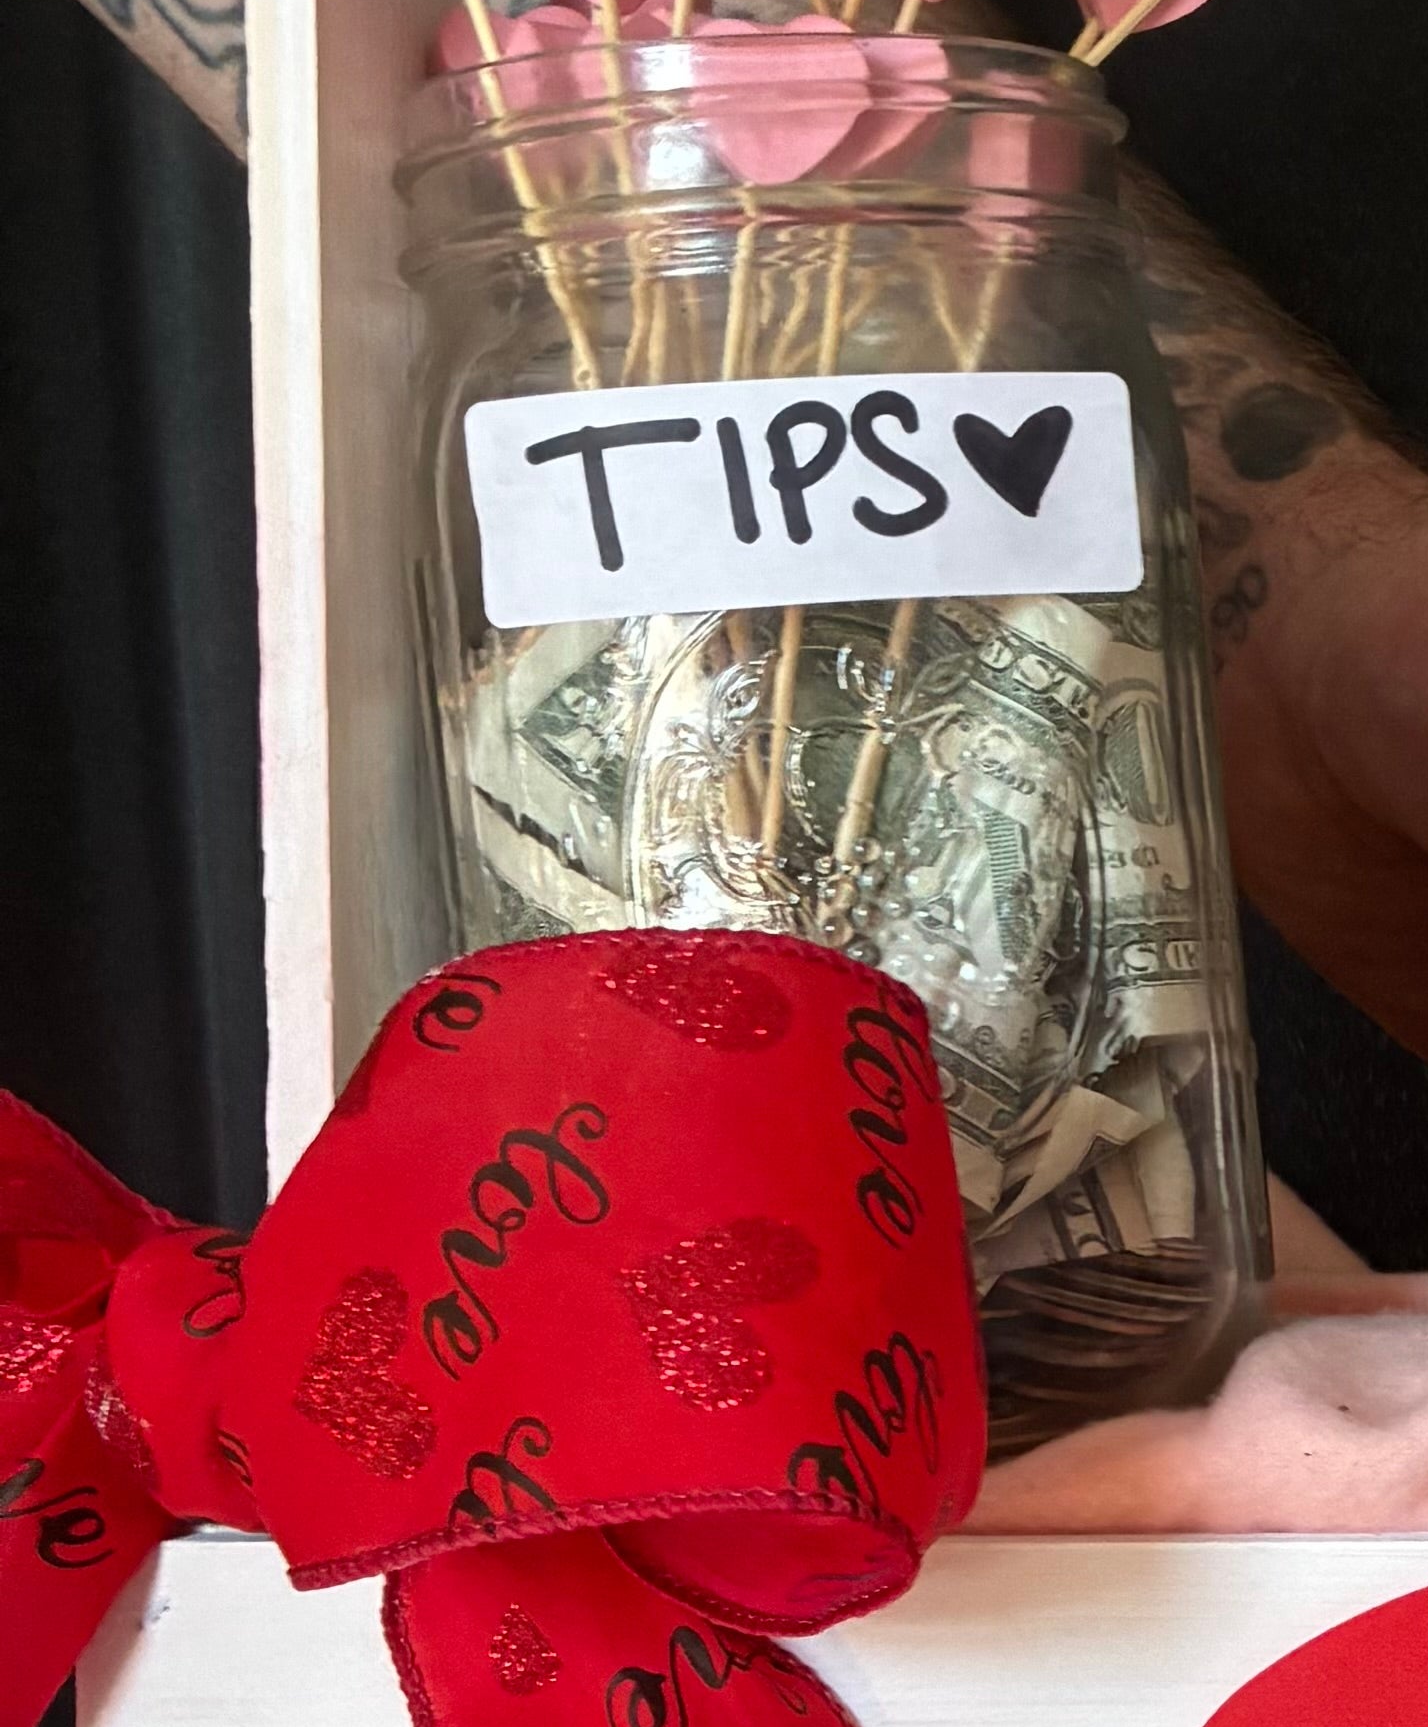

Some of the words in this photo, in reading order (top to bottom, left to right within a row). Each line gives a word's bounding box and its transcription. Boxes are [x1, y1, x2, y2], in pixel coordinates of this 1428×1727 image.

[525, 391, 947, 572] TIPS
[421, 1101, 611, 1381] love
[843, 984, 934, 1250] love
